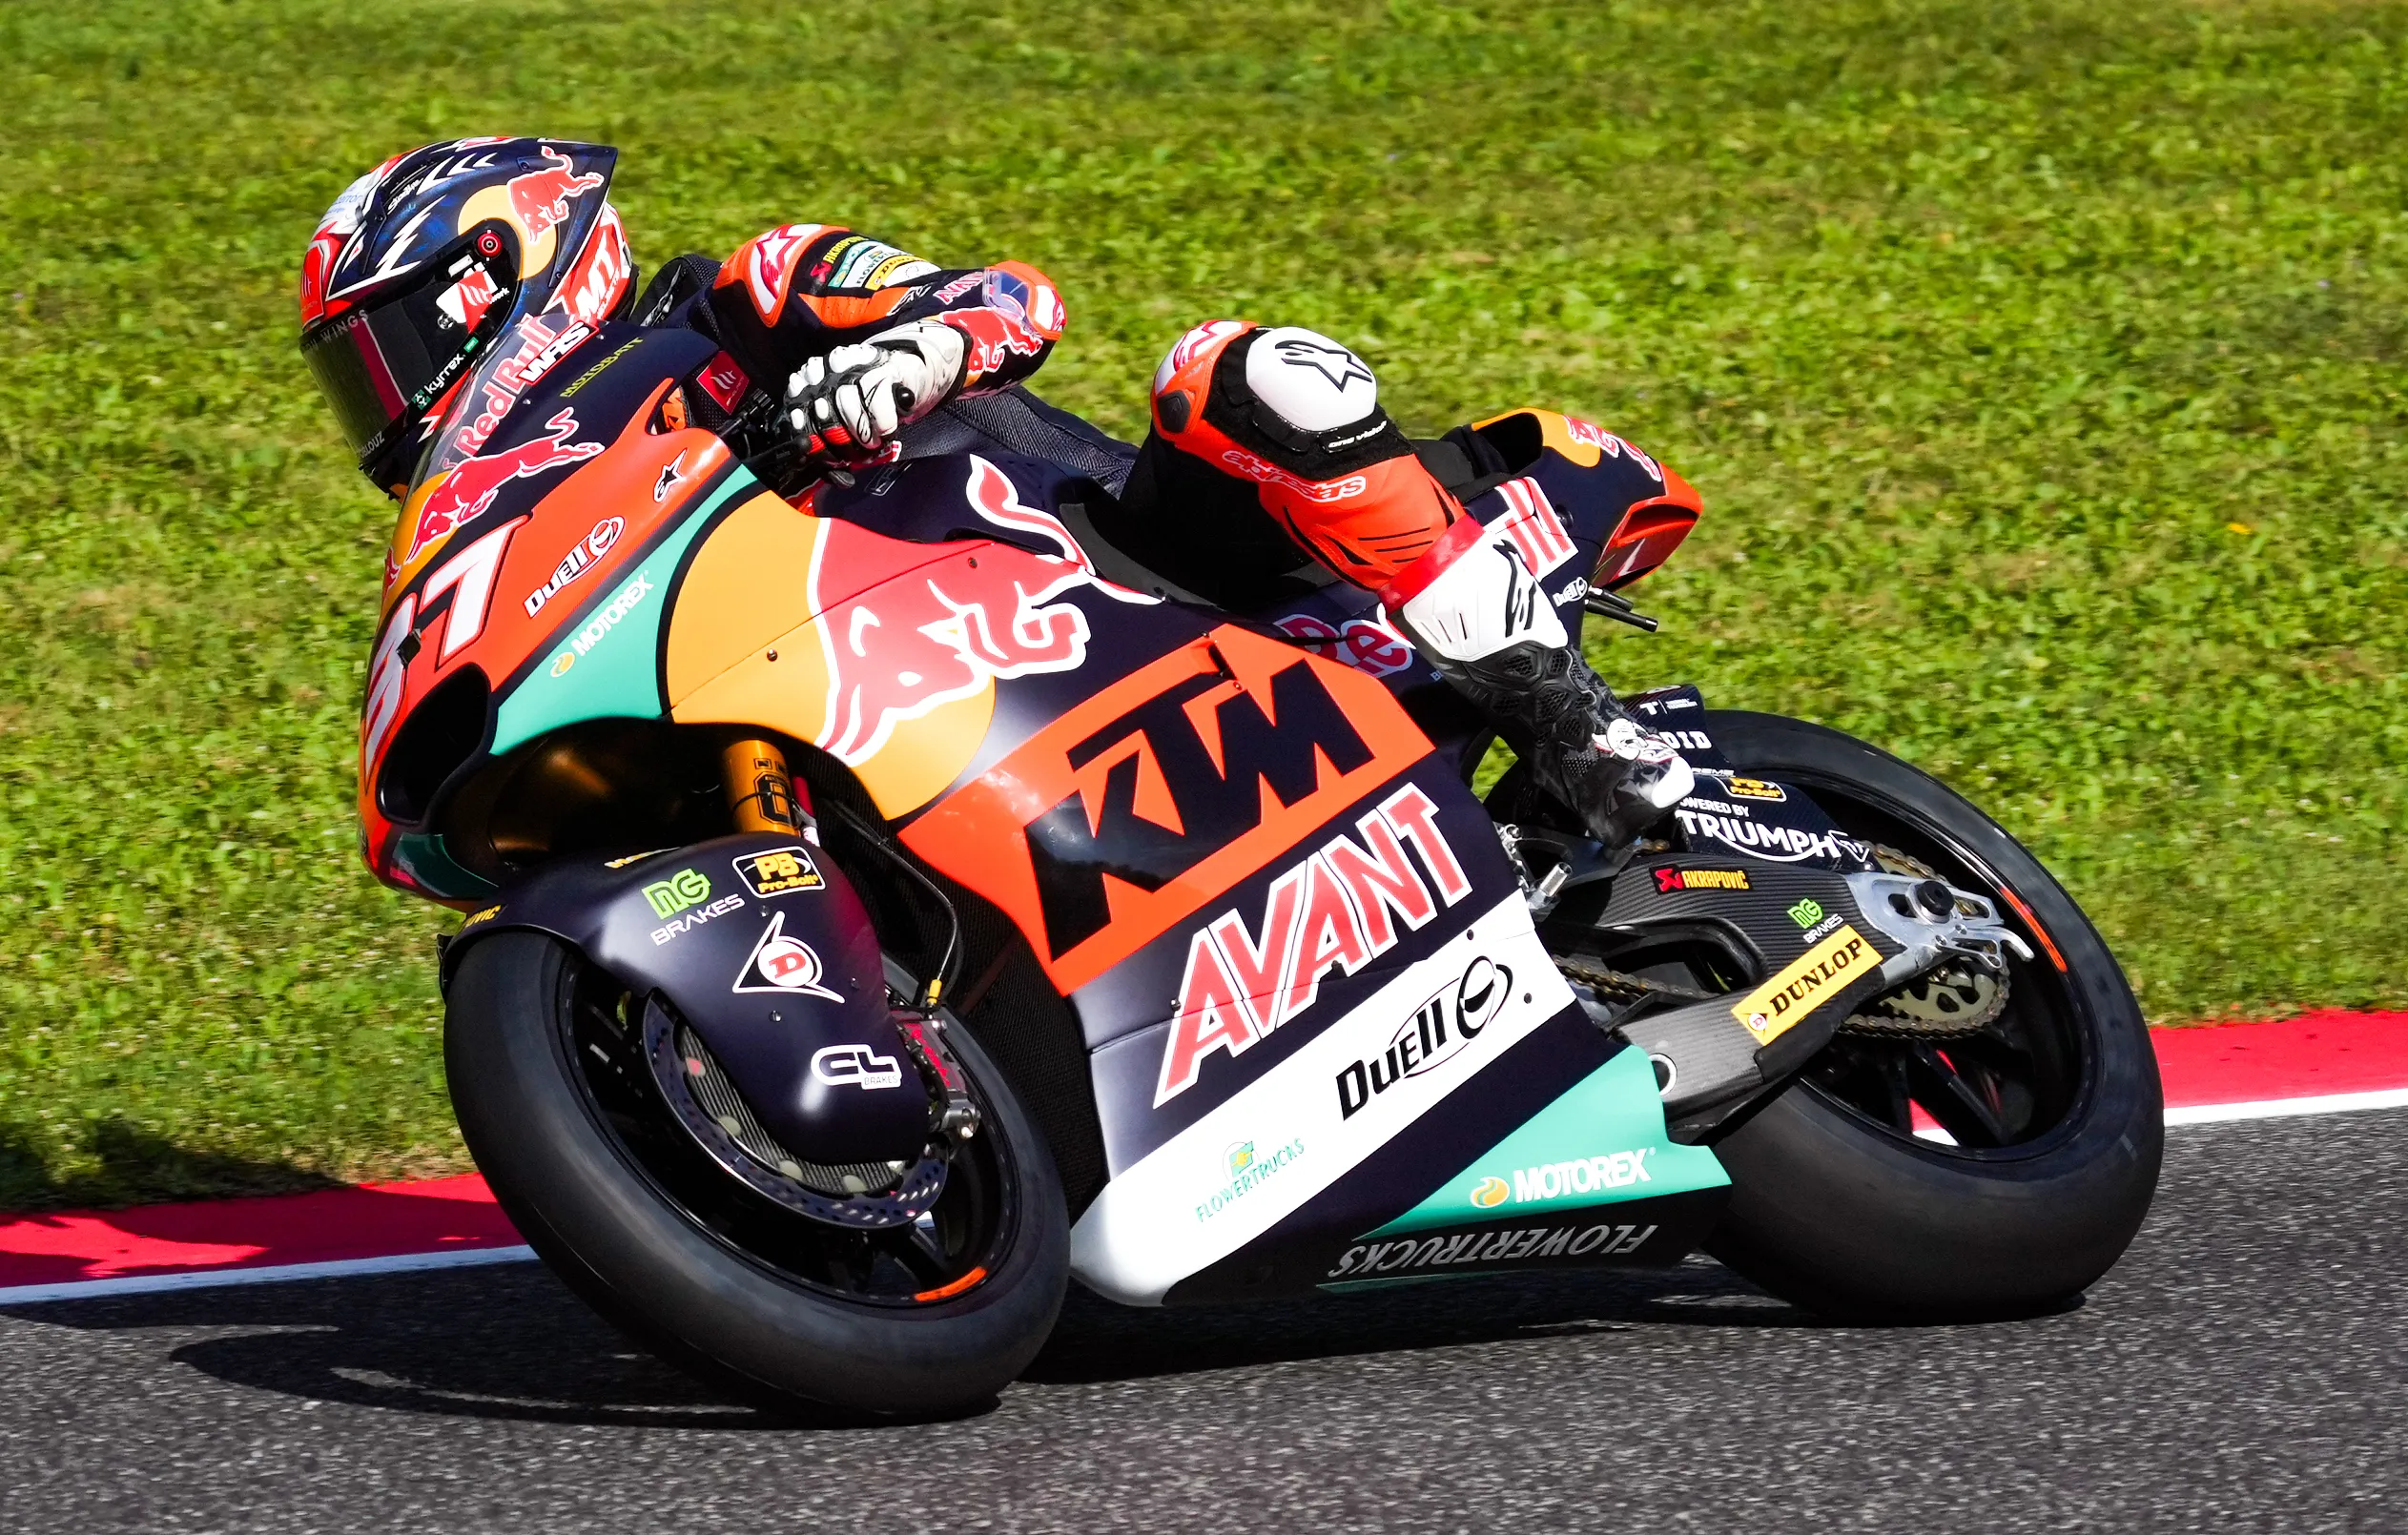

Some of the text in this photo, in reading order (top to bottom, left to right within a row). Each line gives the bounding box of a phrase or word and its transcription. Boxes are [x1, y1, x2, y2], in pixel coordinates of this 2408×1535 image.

[575, 230, 615, 319] MT
[424, 353, 464, 394] kyrrex
[518, 321, 590, 382] WAS
[453, 381, 516, 457] Red
[570, 572, 654, 657] MOTOREX
[1023, 658, 1375, 963] KTM
[1674, 809, 1842, 860] TRIUMPH
[1732, 804, 1750, 817] BY
[752, 851, 800, 881] PB
[649, 893, 746, 946] BRAKES
[1152, 782, 1473, 1110] AVANT
[1803, 913, 1844, 944] BRAKES
[1769, 938, 1863, 1016] DUNLOP
[817, 1050, 896, 1078] CL
[864, 1074, 897, 1086] BRAKES
[1195, 1137, 1305, 1222] FLOWERTRUCKS
[1513, 1148, 1652, 1203] MOTOREX
[1328, 1224, 1659, 1278] FLOWERTRUCKS
